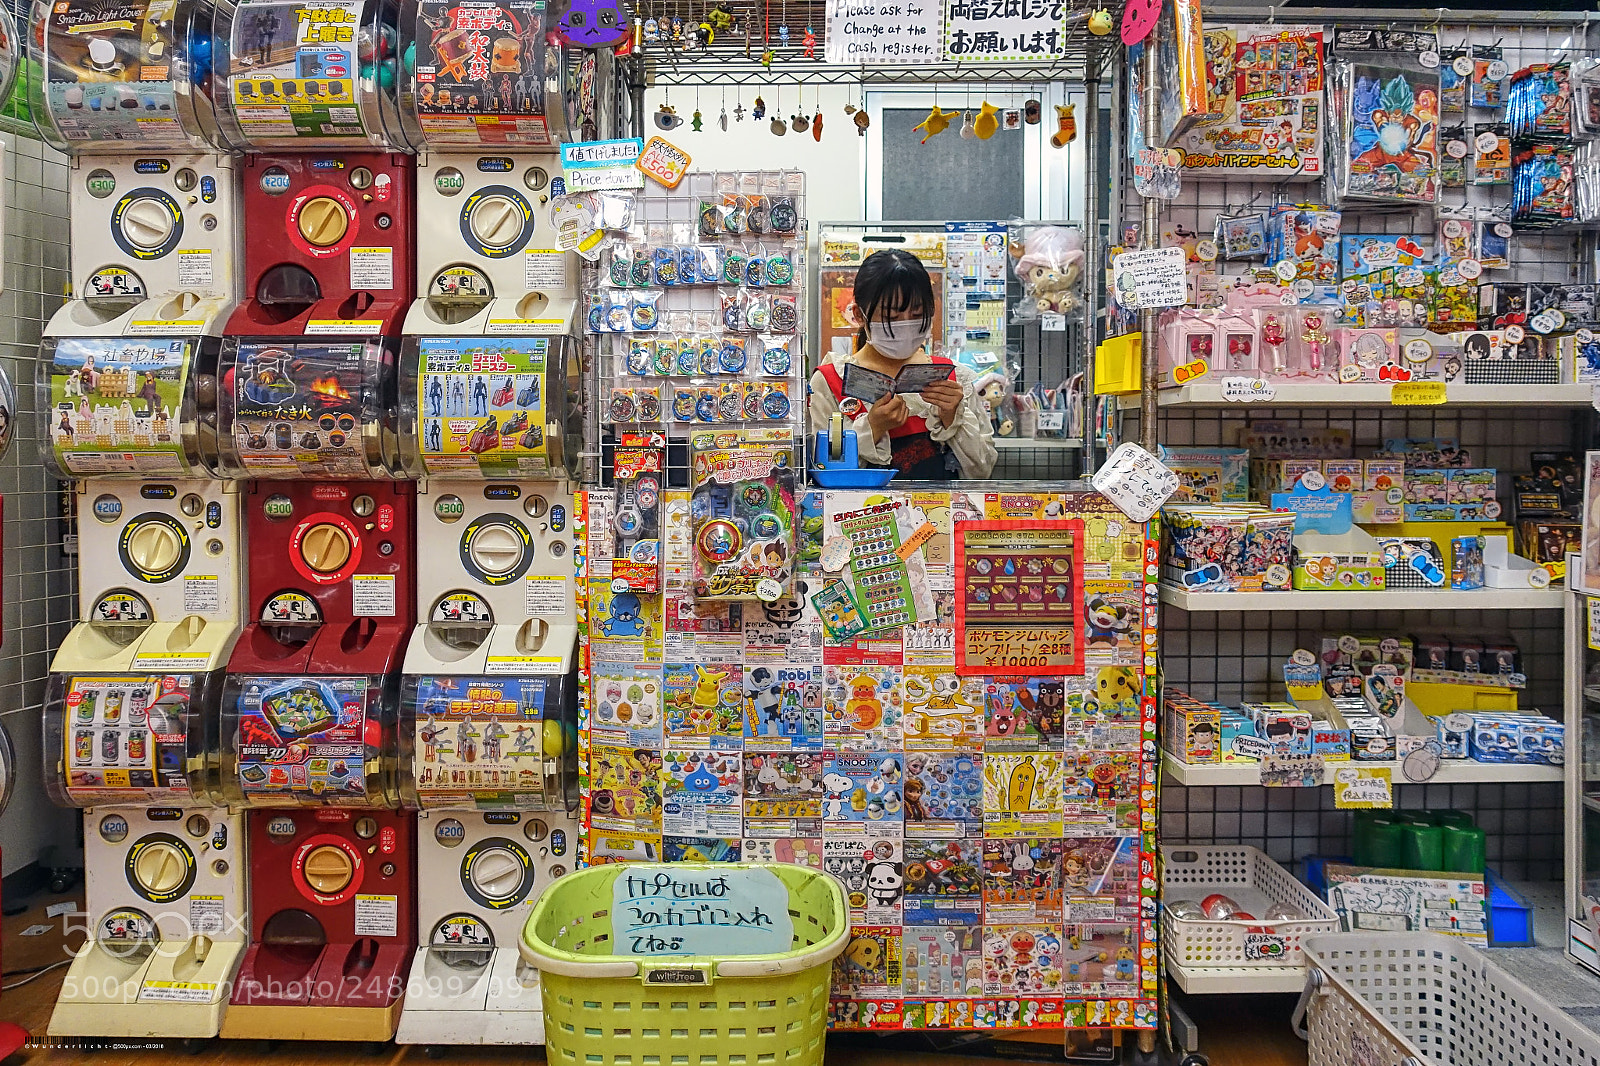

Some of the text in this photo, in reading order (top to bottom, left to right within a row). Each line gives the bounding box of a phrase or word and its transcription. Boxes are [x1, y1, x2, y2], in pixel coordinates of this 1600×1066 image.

[97, 10, 117, 21] Light
[120, 8, 144, 18] Cover
[835, 0, 924, 17] Please ask for
[295, 8, 356, 23] 下駄箱と
[302, 25, 353, 43] 上履き
[844, 23, 926, 36] Change at the
[951, 28, 1063, 54] お願いします。
[882, 42, 933, 55] register.
[468, 31, 490, 80] 和太鼓
[648, 150, 666, 163] ALL
[643, 158, 673, 180] ¥500
[265, 176, 289, 187] ¥200
[438, 178, 462, 188] ¥300
[572, 171, 601, 186] Price
[473, 362, 516, 372] コースター
[274, 403, 313, 421] たき火
[97, 502, 122, 513] ¥200
[267, 504, 292, 514] ¥300
[438, 503, 463, 514] ¥300
[1001, 500, 1045, 509] SNOOPY
[969, 630, 1070, 642] ポケモンジムバッジ
[985, 656, 1048, 667] ¥10000
[778, 670, 811, 681] Robi
[450, 701, 518, 715] ラテンな楽器
[838, 758, 880, 767] SNOOPY
[104, 822, 128, 833] ¥200
[271, 822, 295, 833] ¥200
[438, 826, 463, 837] ¥200
[824, 841, 867, 850] おじぱん
[626, 874, 730, 898] カプセルは
[628, 904, 774, 927] このカゴに入れ
